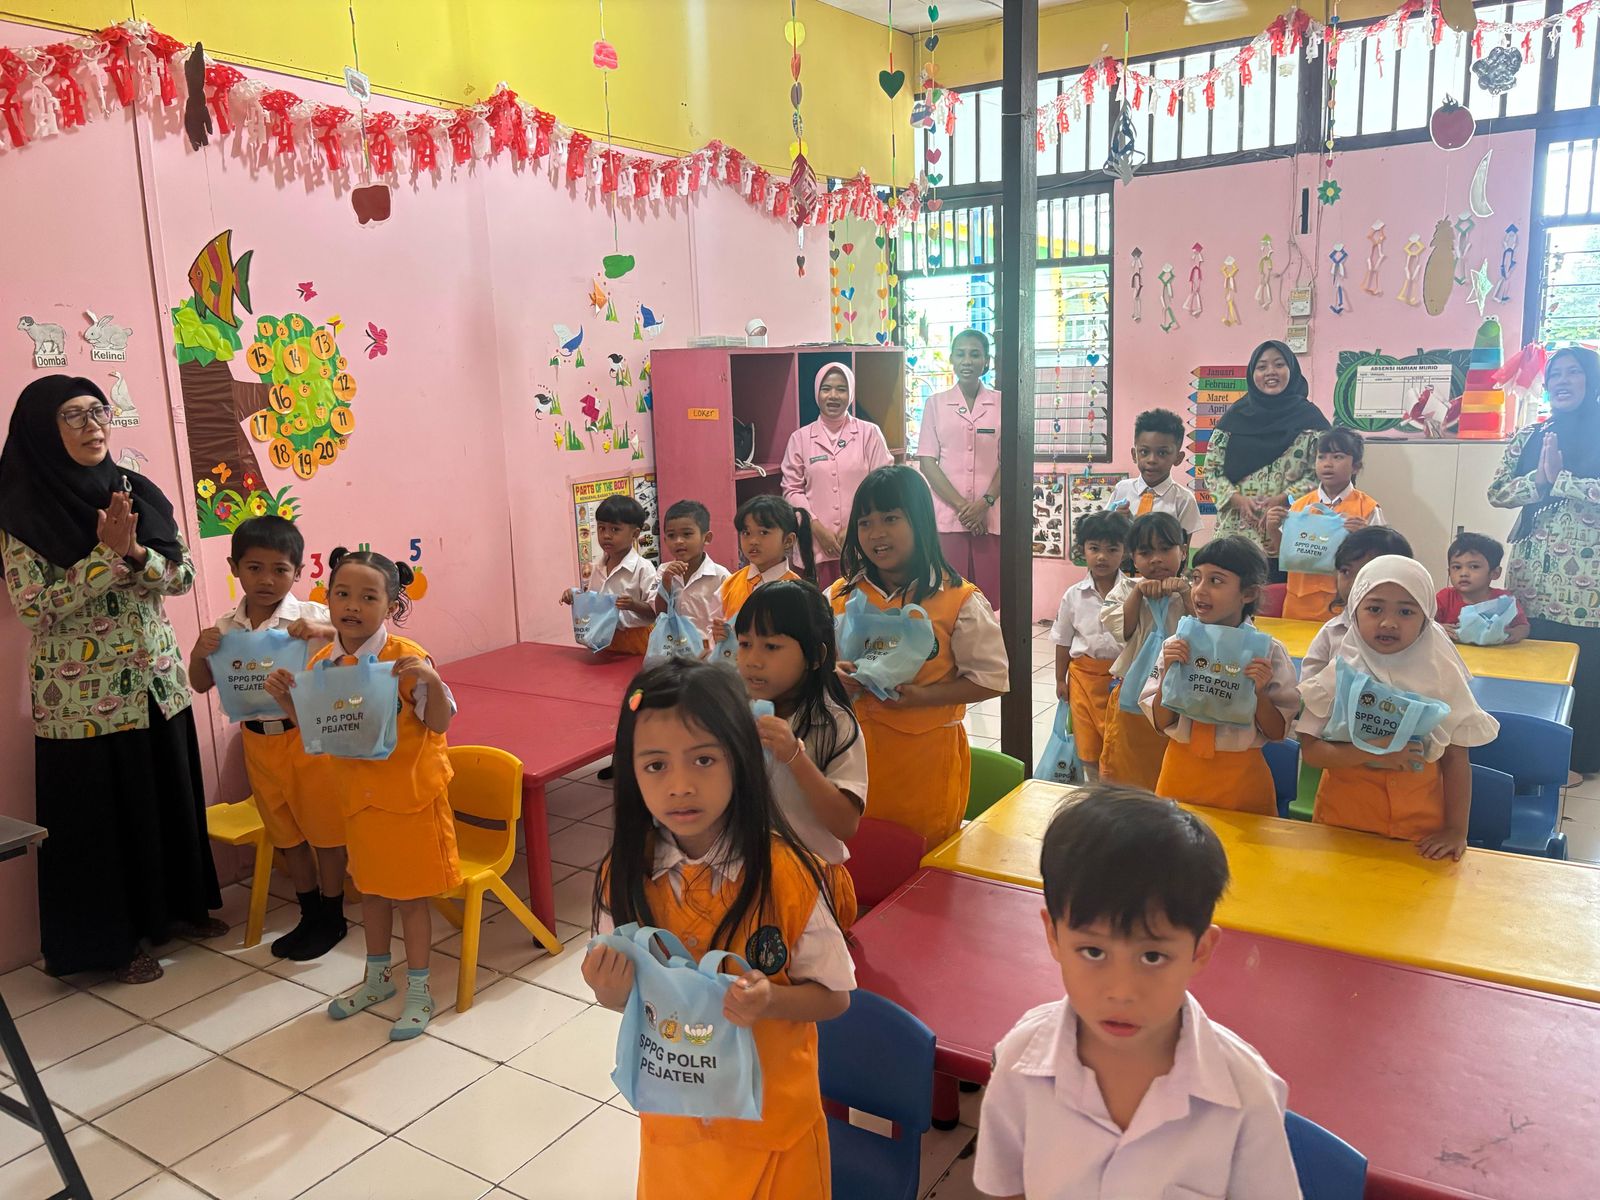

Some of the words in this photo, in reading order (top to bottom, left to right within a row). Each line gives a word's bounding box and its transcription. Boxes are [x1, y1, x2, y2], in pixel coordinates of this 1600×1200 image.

[280, 327, 285, 336] 2
[295, 320, 300, 328] 3
[315, 334, 331, 354] 13
[36, 356, 67, 367] Domba
[93, 351, 125, 361] Kelinci
[251, 346, 267, 368] 15
[288, 348, 302, 368] 14
[1207, 368, 1235, 376] Januari
[302, 386, 308, 394] 6
[337, 374, 350, 391] 12
[1205, 379, 1236, 389] Februari
[271, 385, 292, 410] 16
[1206, 393, 1229, 402] Maret
[1208, 404, 1227, 414] April
[109, 419, 139, 428] Angsa
[253, 414, 268, 436] 17
[337, 412, 348, 426] 11
[273, 443, 291, 465] 18
[314, 440, 335, 460] 20
[298, 453, 312, 476] 19
[575, 484, 595, 496] PARTS
[595, 482, 602, 493] OF
[603, 481, 613, 491] THE
[614, 479, 628, 490] BODY
[409, 538, 422, 561] 5
[1294, 541, 1310, 549] SPPG
[1310, 544, 1328, 552] POLRI
[1296, 547, 1322, 557] PEJATEN
[309, 552, 324, 579] 3
[228, 674, 250, 683] SPPG
[1188, 673, 1212, 684] SPPG
[1213, 678, 1240, 691] POLRI
[1193, 683, 1233, 700] PEJATEN
[321, 722, 360, 734] PEJATEN
[1355, 711, 1381, 725] SPPG
[1382, 718, 1400, 730] PO
[640, 1033, 665, 1061] SPPG
[667, 1051, 717, 1069] POLRI
[640, 1057, 705, 1084] PEJATEN
